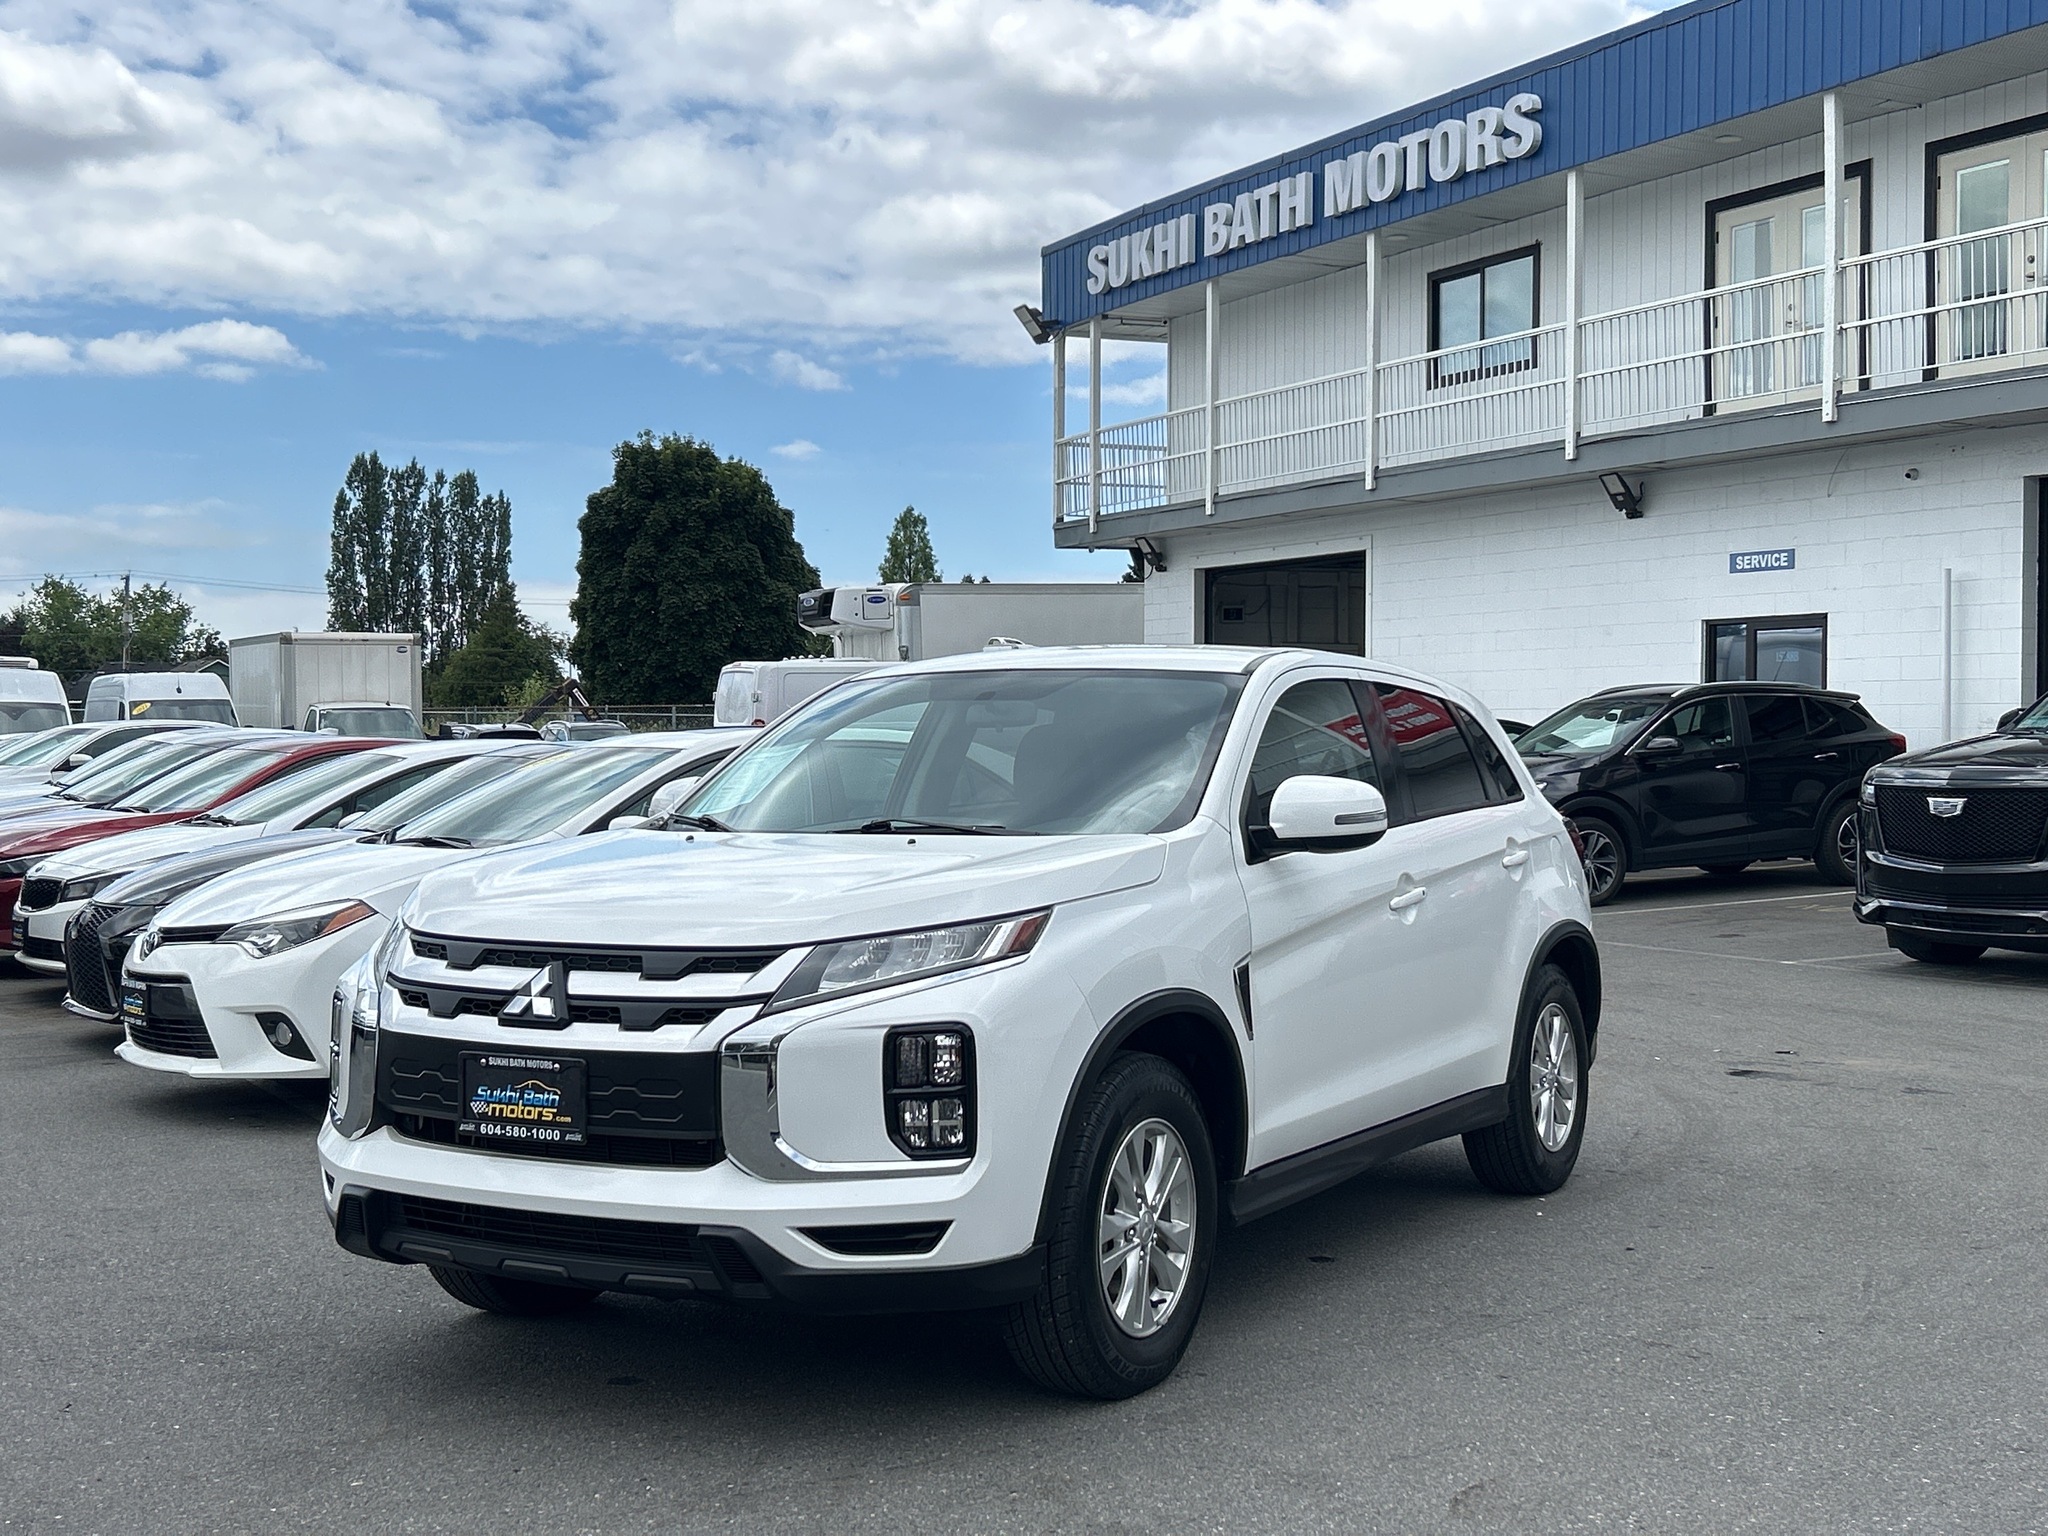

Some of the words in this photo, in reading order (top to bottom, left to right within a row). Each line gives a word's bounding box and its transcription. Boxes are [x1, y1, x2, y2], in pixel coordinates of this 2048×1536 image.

[1087, 213, 1196, 295] SUKHI
[1204, 171, 1313, 257] BATH
[1324, 92, 1542, 218] MOTORS
[1736, 552, 1788, 569] SERVICE
[488, 1056, 509, 1067] SUKHI
[527, 1059, 553, 1070] MOTORS
[473, 1085, 519, 1104] Sukhi
[523, 1089, 560, 1107] Bath
[480, 1123, 560, 1141] 604-580-1000
